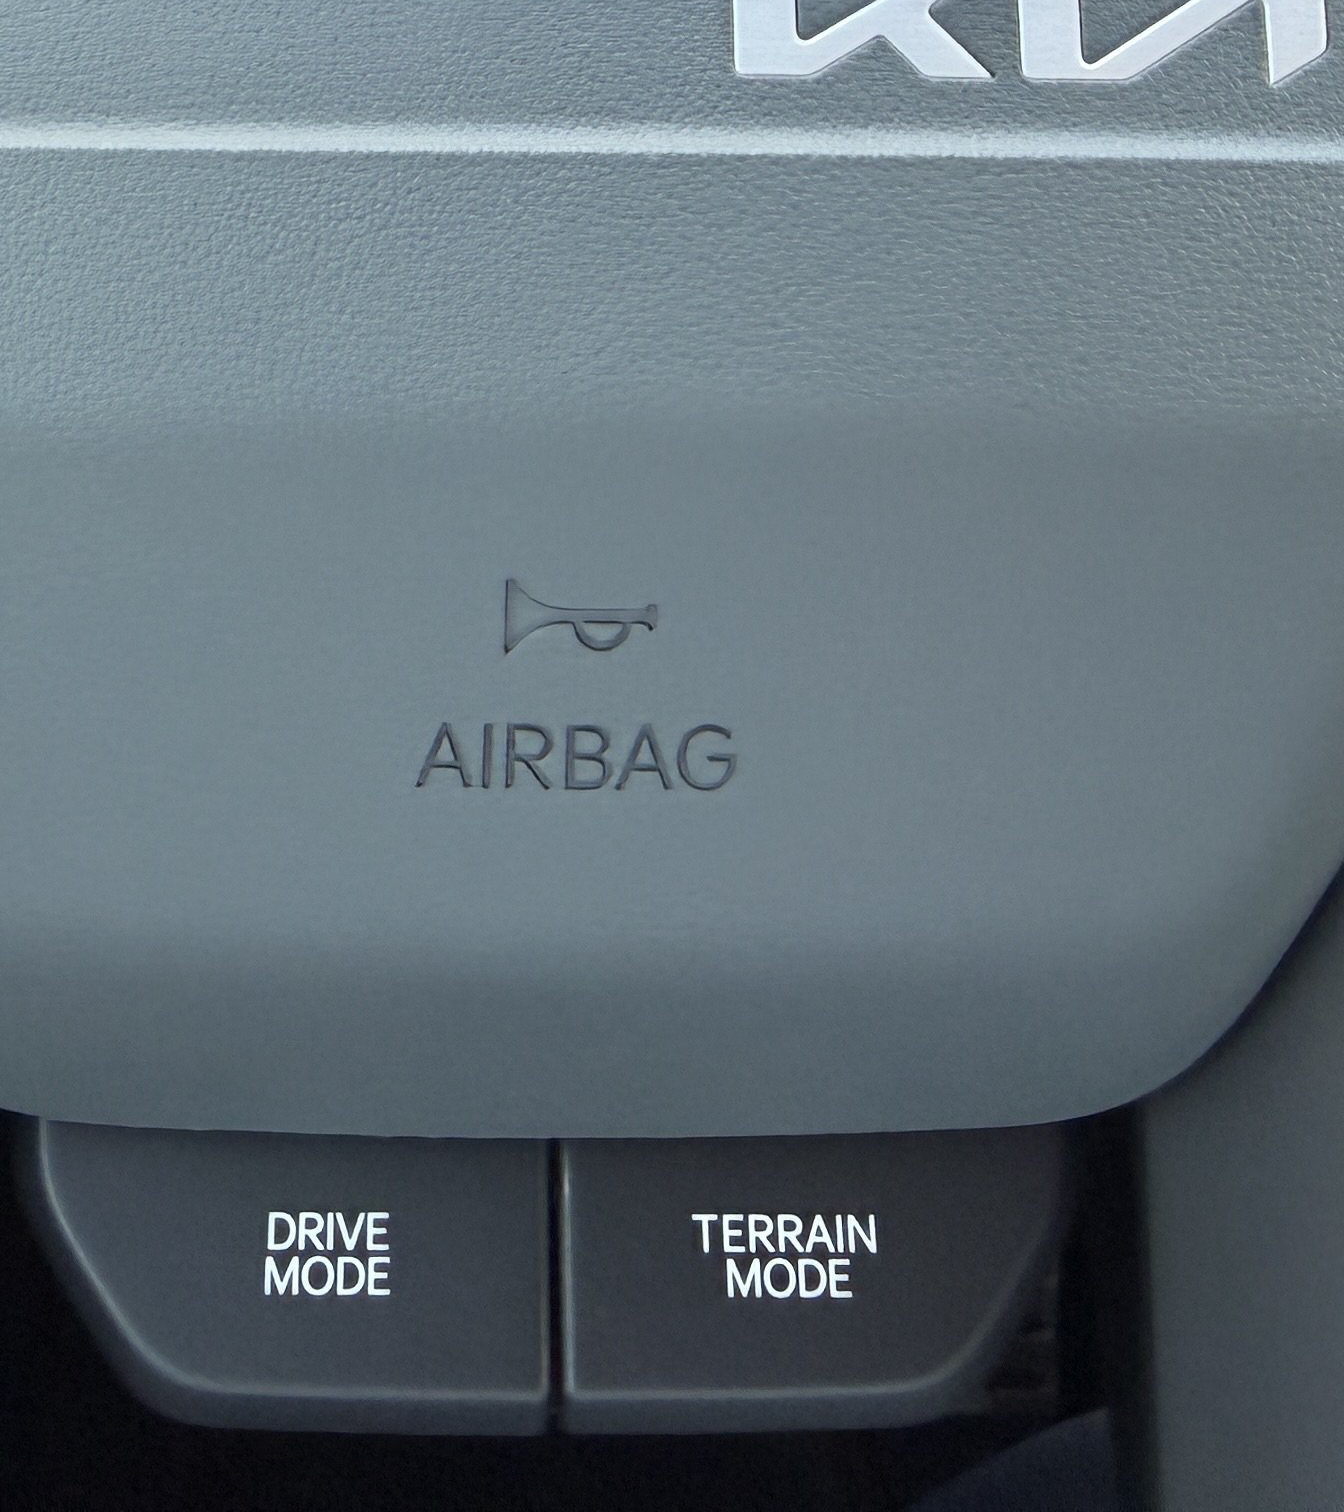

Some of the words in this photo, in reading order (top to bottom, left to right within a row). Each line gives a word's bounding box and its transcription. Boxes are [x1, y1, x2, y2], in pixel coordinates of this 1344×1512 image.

[414, 721, 738, 791] AIRBAG
[266, 1211, 391, 1253] DRIVE
[691, 1213, 878, 1256] TERRAIN
[263, 1256, 392, 1297] MODE
[724, 1257, 854, 1299] MODE
